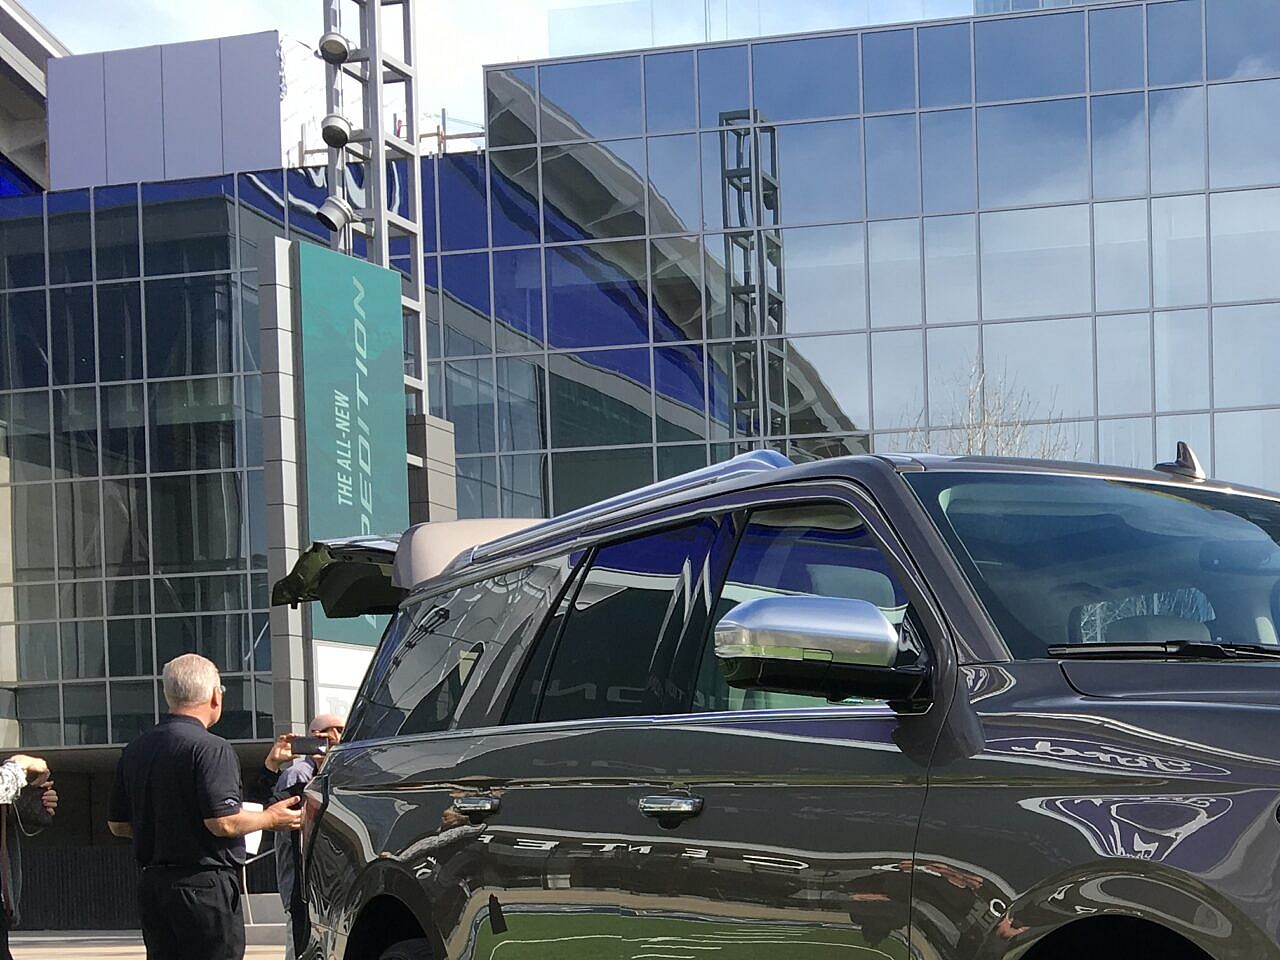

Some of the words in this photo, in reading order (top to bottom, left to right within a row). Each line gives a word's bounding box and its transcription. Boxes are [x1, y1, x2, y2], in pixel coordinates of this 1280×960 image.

[334, 389, 351, 471] ALL-NEW
[352, 276, 376, 629] PEDITION
[337, 472, 352, 505] THE
